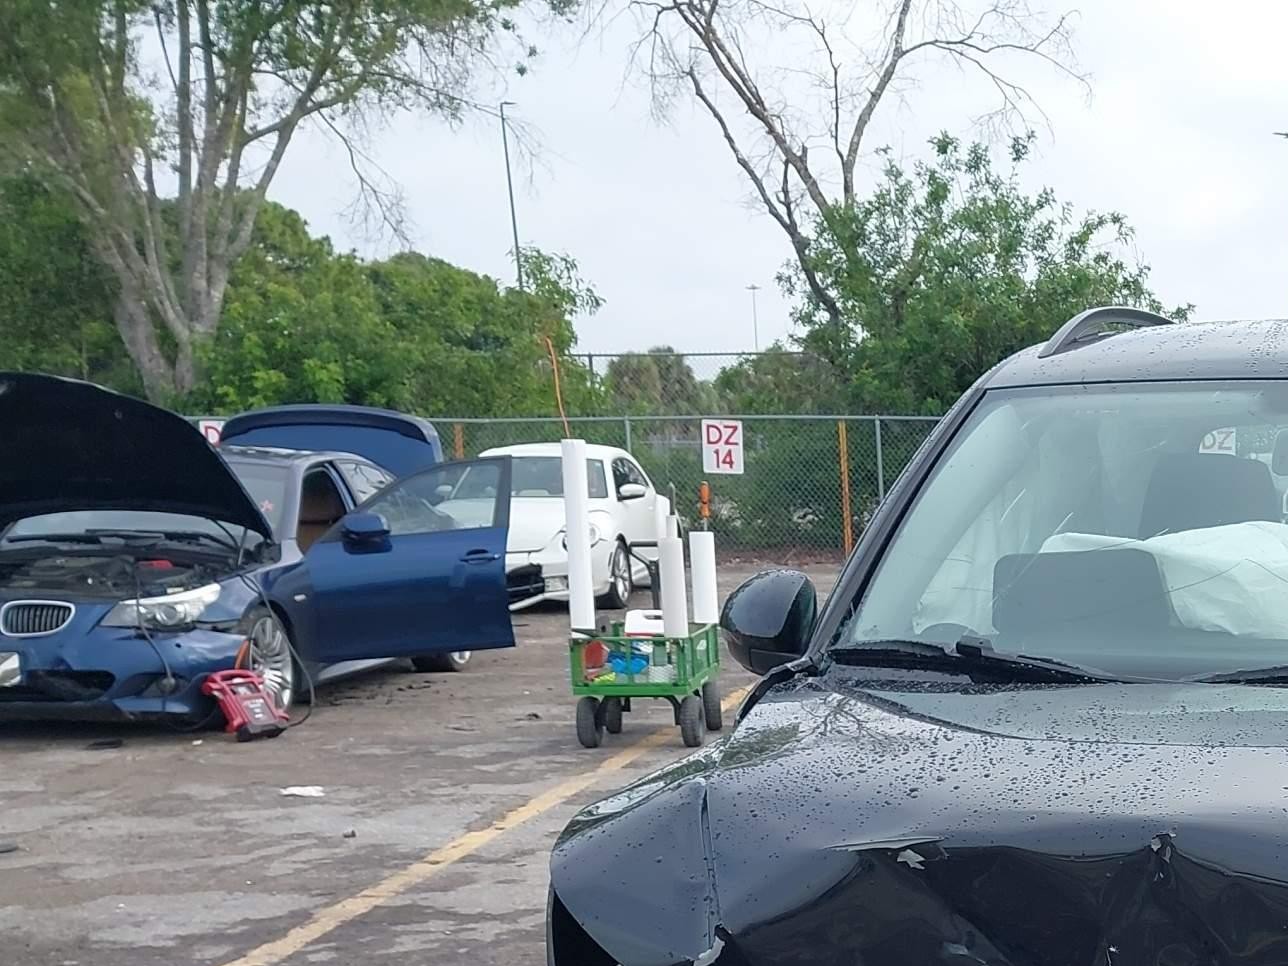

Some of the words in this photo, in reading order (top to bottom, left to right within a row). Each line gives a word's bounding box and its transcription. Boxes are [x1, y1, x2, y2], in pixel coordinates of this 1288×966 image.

[706, 424, 739, 446] DZ
[1202, 430, 1233, 450] DZ
[713, 449, 734, 469] 14
